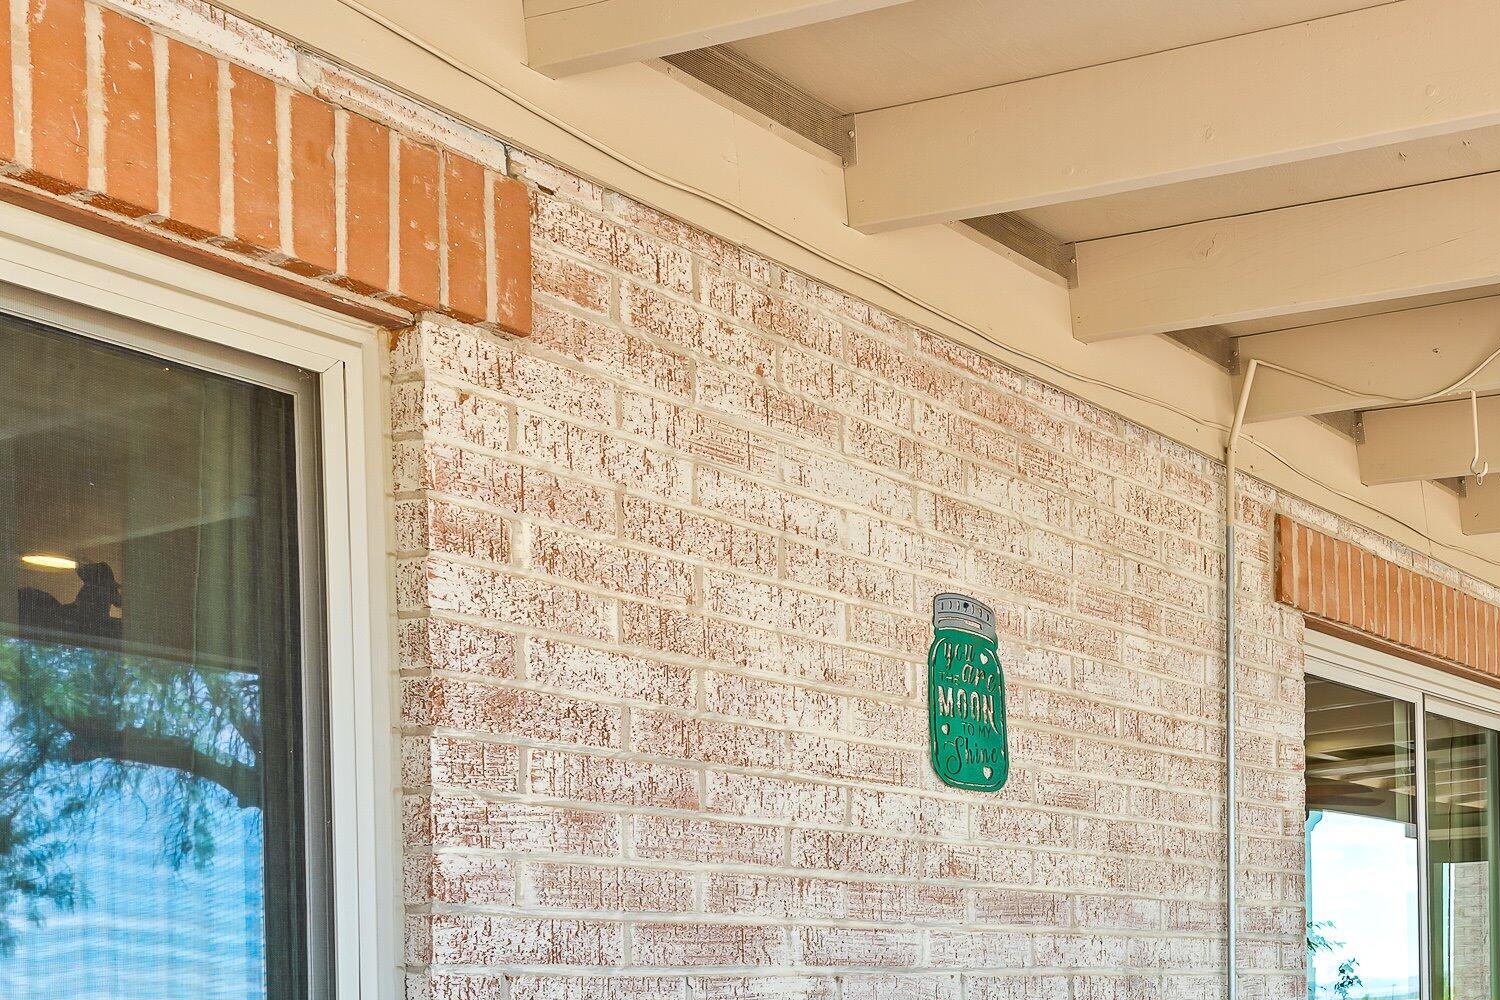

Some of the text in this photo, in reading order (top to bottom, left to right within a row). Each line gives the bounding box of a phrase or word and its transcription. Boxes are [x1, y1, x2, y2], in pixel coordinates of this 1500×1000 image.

[937, 685, 1001, 735] MOON
[961, 721, 993, 739] TO MY
[943, 736, 999, 775] Shine
